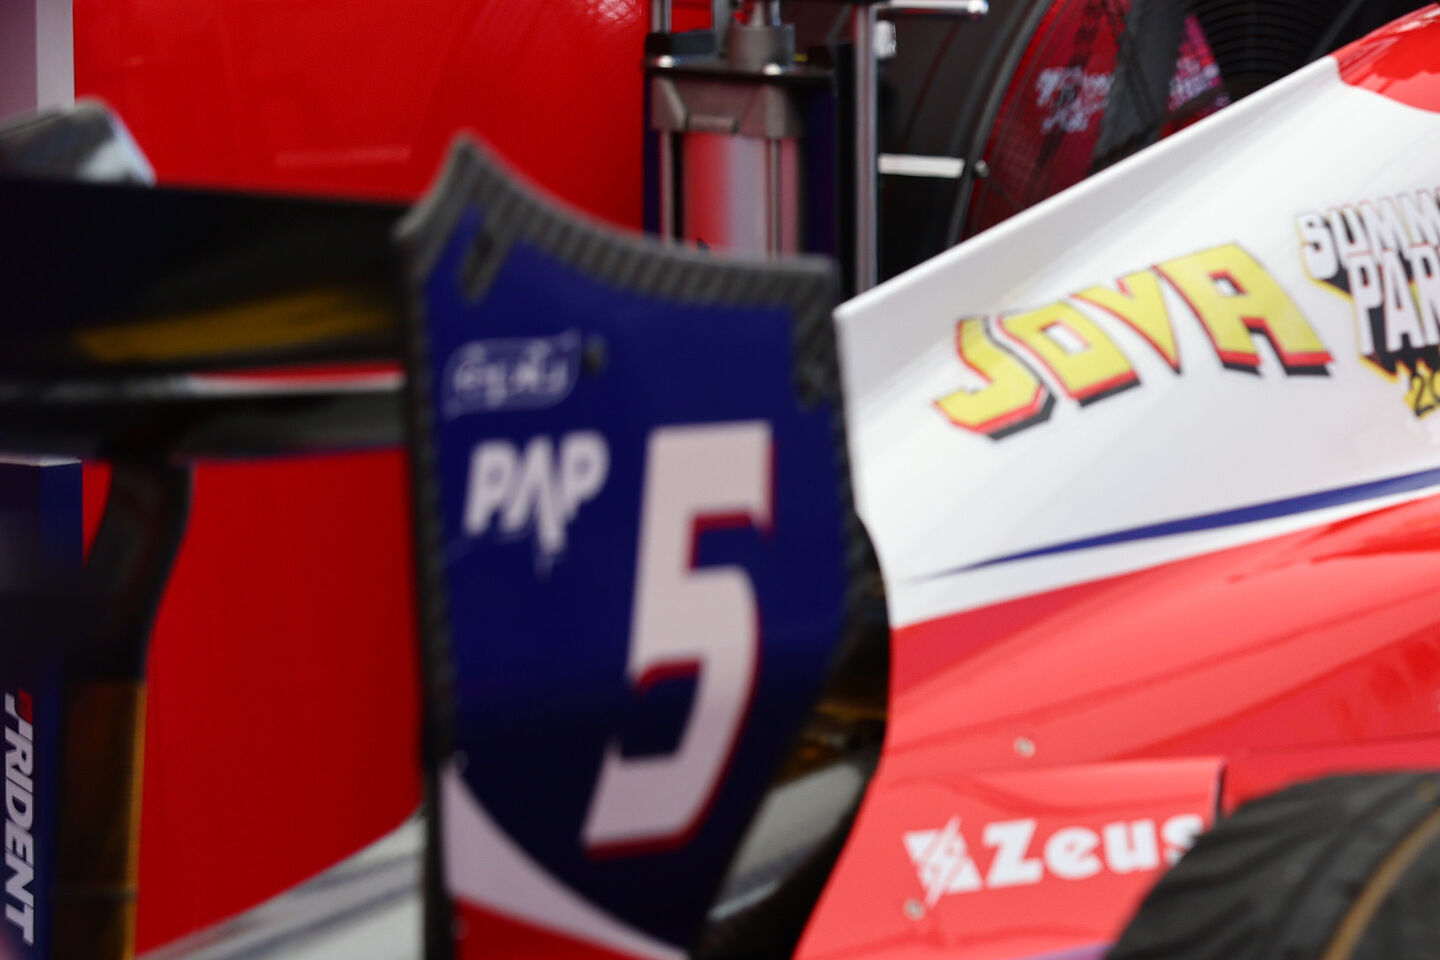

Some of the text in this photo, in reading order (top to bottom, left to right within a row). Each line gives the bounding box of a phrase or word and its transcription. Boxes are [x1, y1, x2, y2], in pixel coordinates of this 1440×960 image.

[933, 243, 1335, 441] JOVA
[580, 418, 776, 858] 5
[5, 687, 34, 946] TRIDENT
